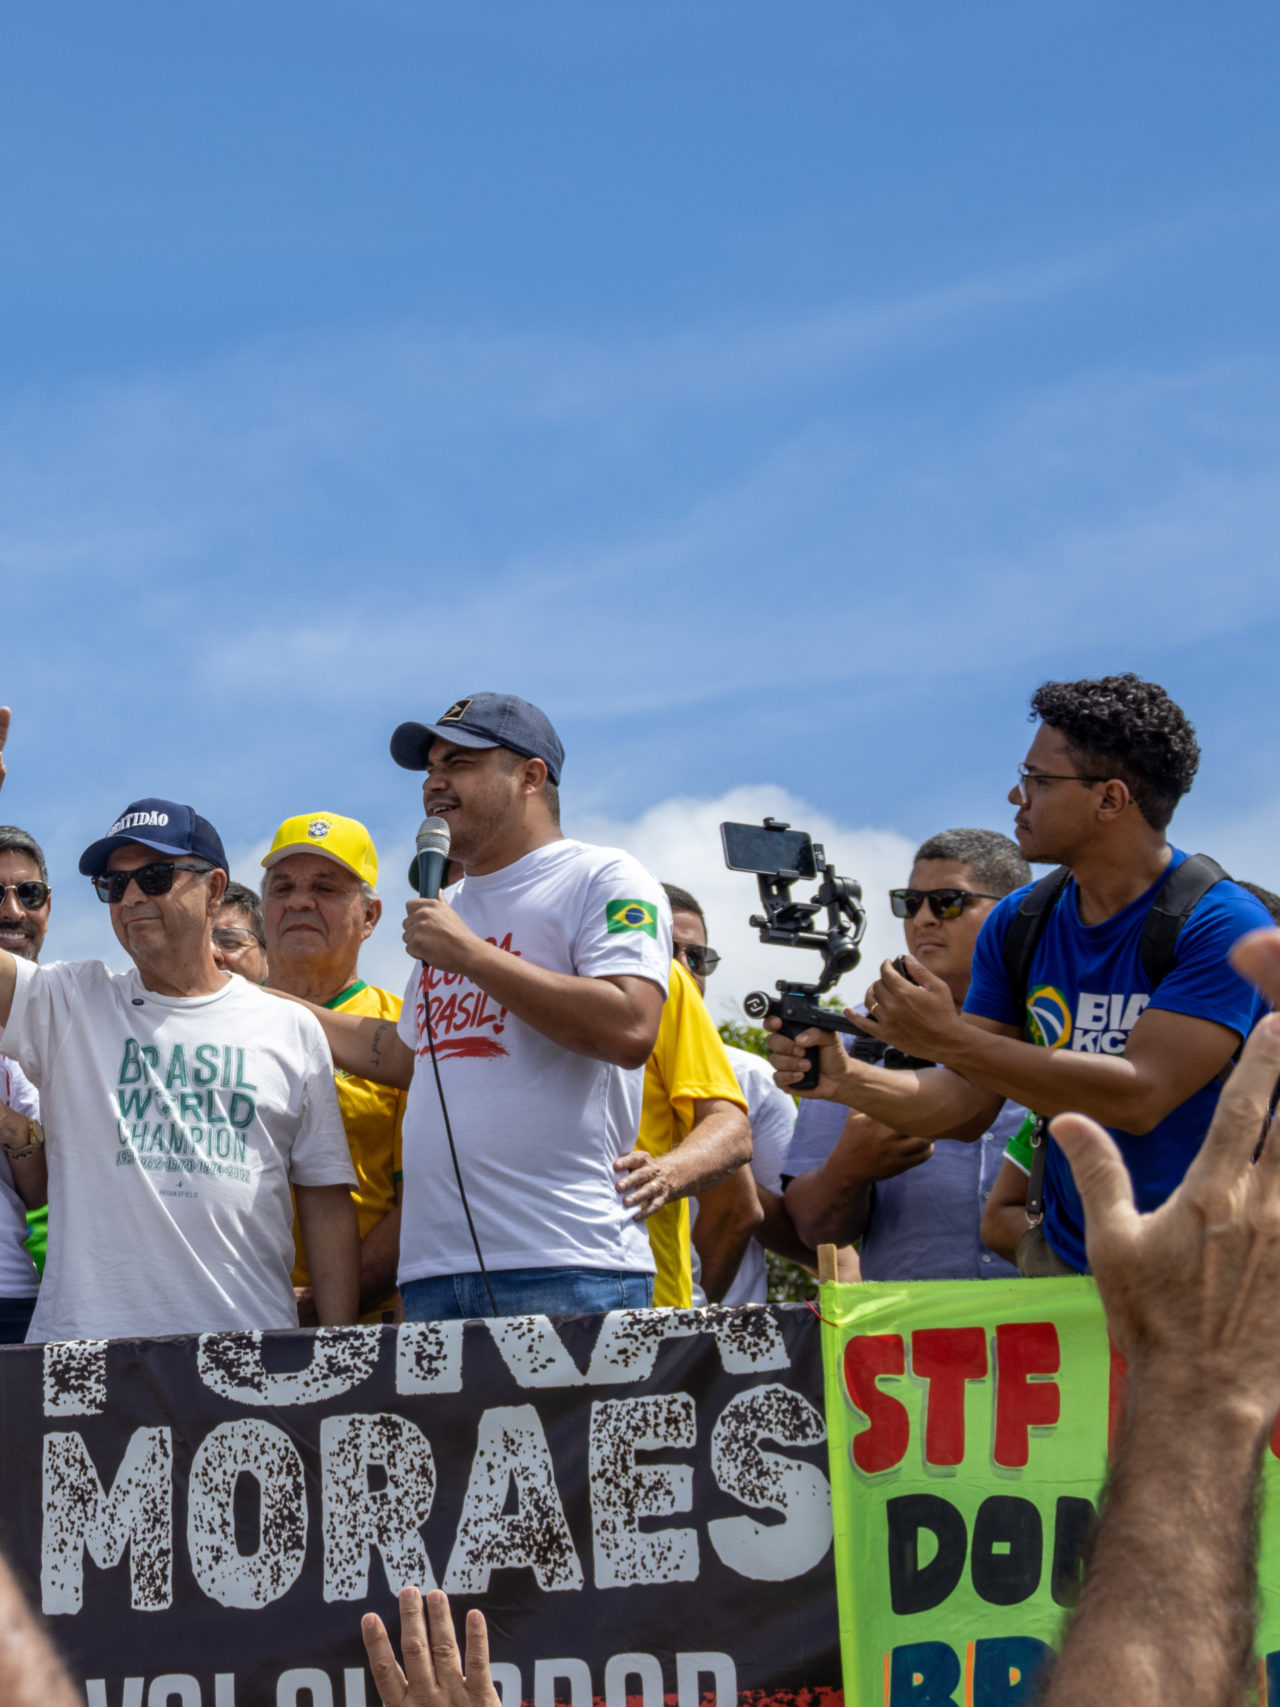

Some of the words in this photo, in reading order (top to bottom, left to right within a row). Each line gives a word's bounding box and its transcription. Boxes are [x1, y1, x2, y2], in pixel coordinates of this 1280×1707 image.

[119, 1037, 258, 1091] BRASIL
[117, 1117, 246, 1163] CHAMPION
[841, 1321, 1062, 1482] STF
[40, 1383, 834, 1616] MORAES
